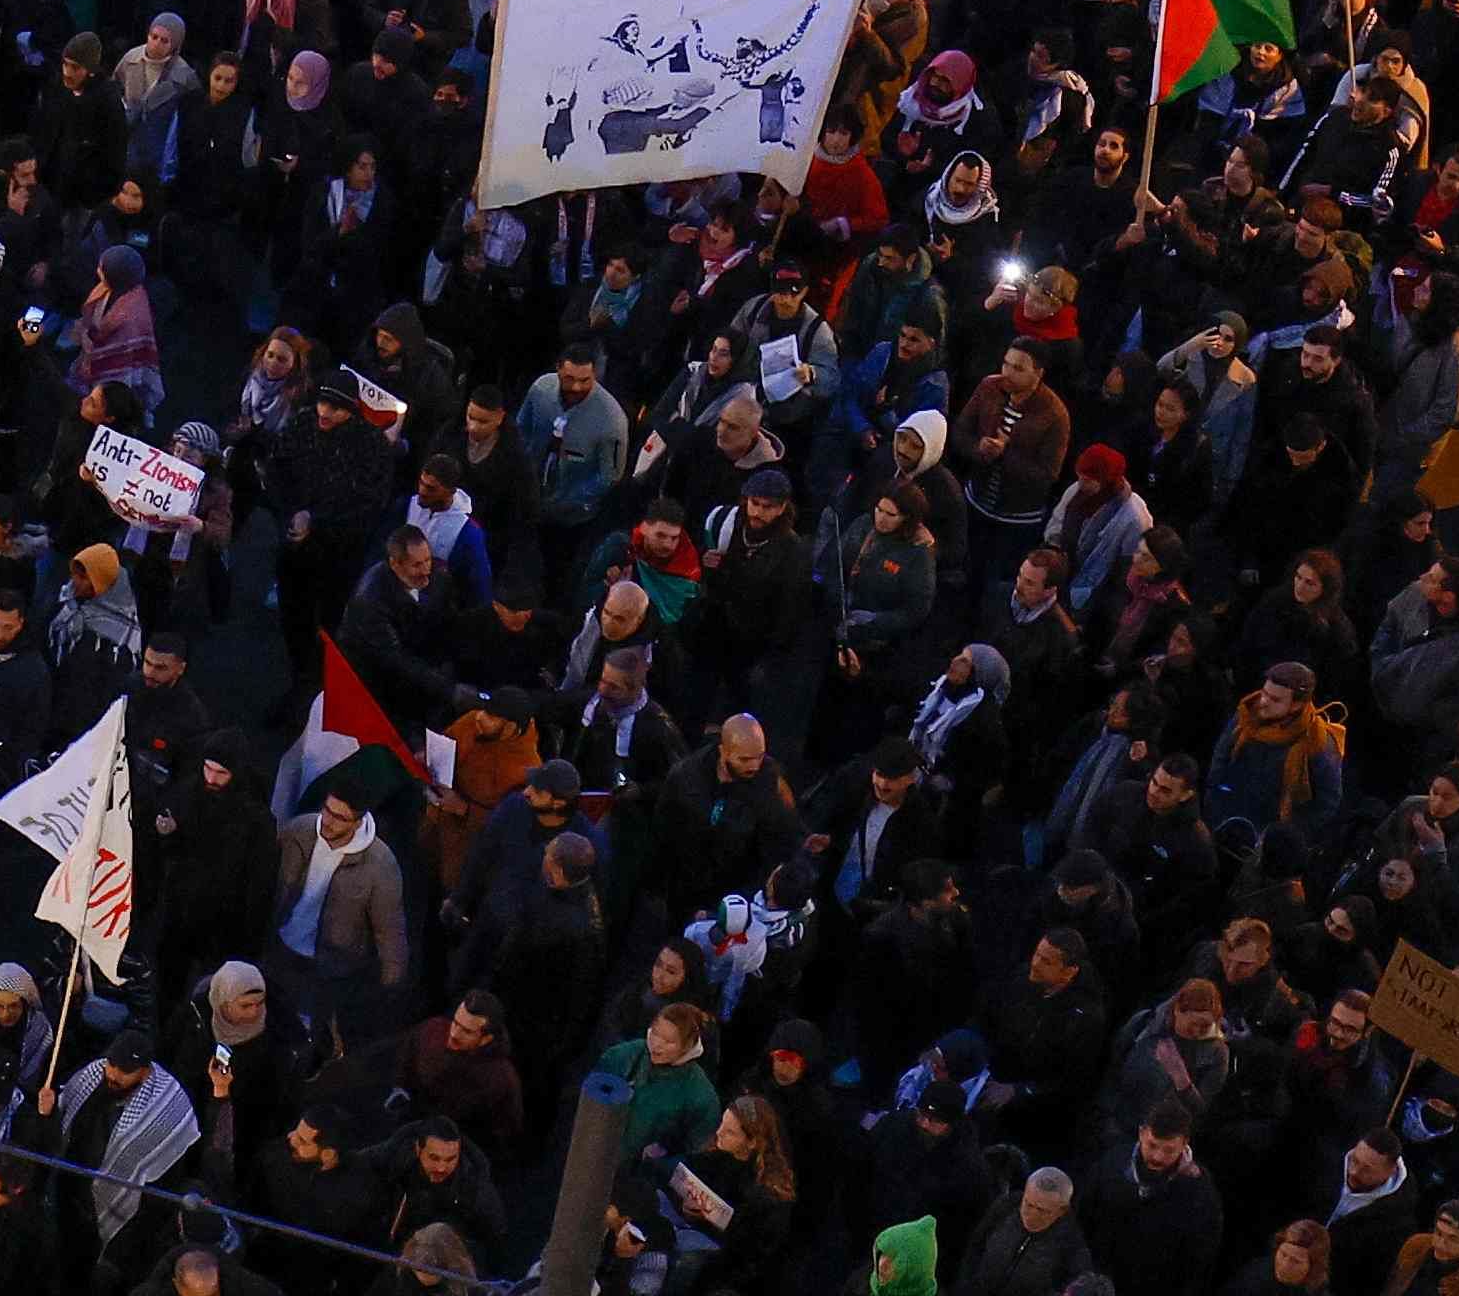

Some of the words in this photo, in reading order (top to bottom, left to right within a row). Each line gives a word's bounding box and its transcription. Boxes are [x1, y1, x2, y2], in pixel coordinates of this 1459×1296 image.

[91, 429, 199, 495] Anti-Zionism
[92, 462, 109, 482] is
[142, 487, 172, 512] not
[1399, 954, 1446, 999] NOT
